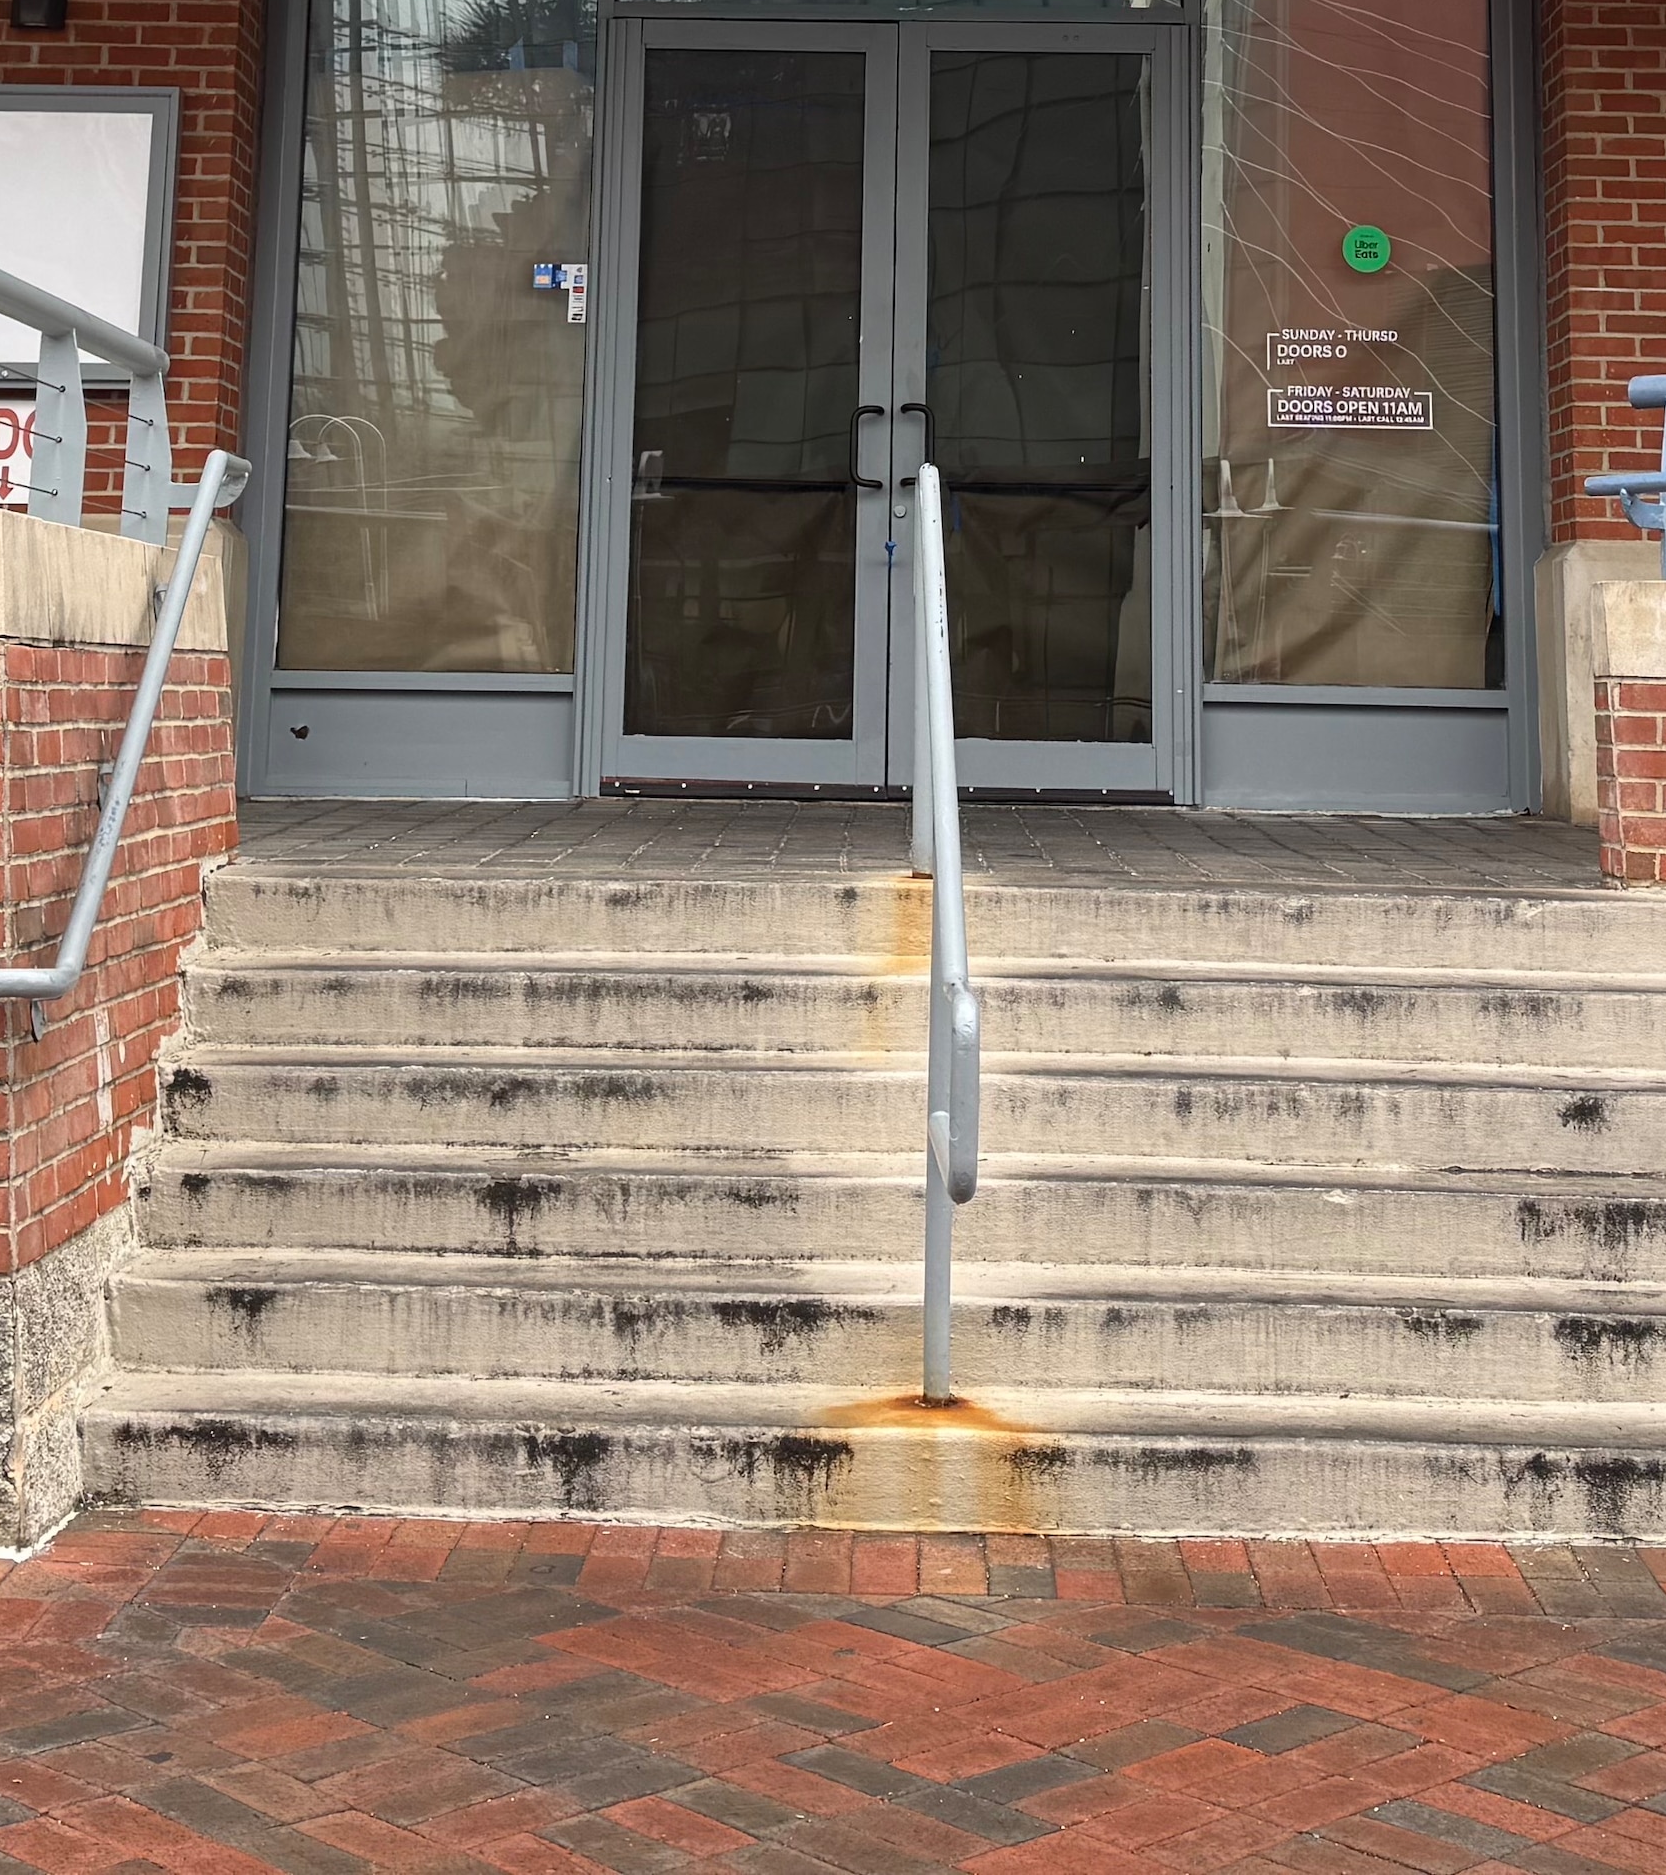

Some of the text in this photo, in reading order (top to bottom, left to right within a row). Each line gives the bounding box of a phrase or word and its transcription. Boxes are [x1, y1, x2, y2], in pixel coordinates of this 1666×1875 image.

[1355, 240, 1378, 249] Uber
[1355, 250, 1379, 259] Eats
[1282, 329, 1335, 341] SUNDAY
[1344, 330, 1398, 342] THURSD
[1277, 344, 1347, 358] DOORS O
[1287, 385, 1333, 397] FRIDAY
[1342, 386, 1411, 399] SATURDAY
[1277, 399, 1422, 415] DOORS OPEN 11AM
